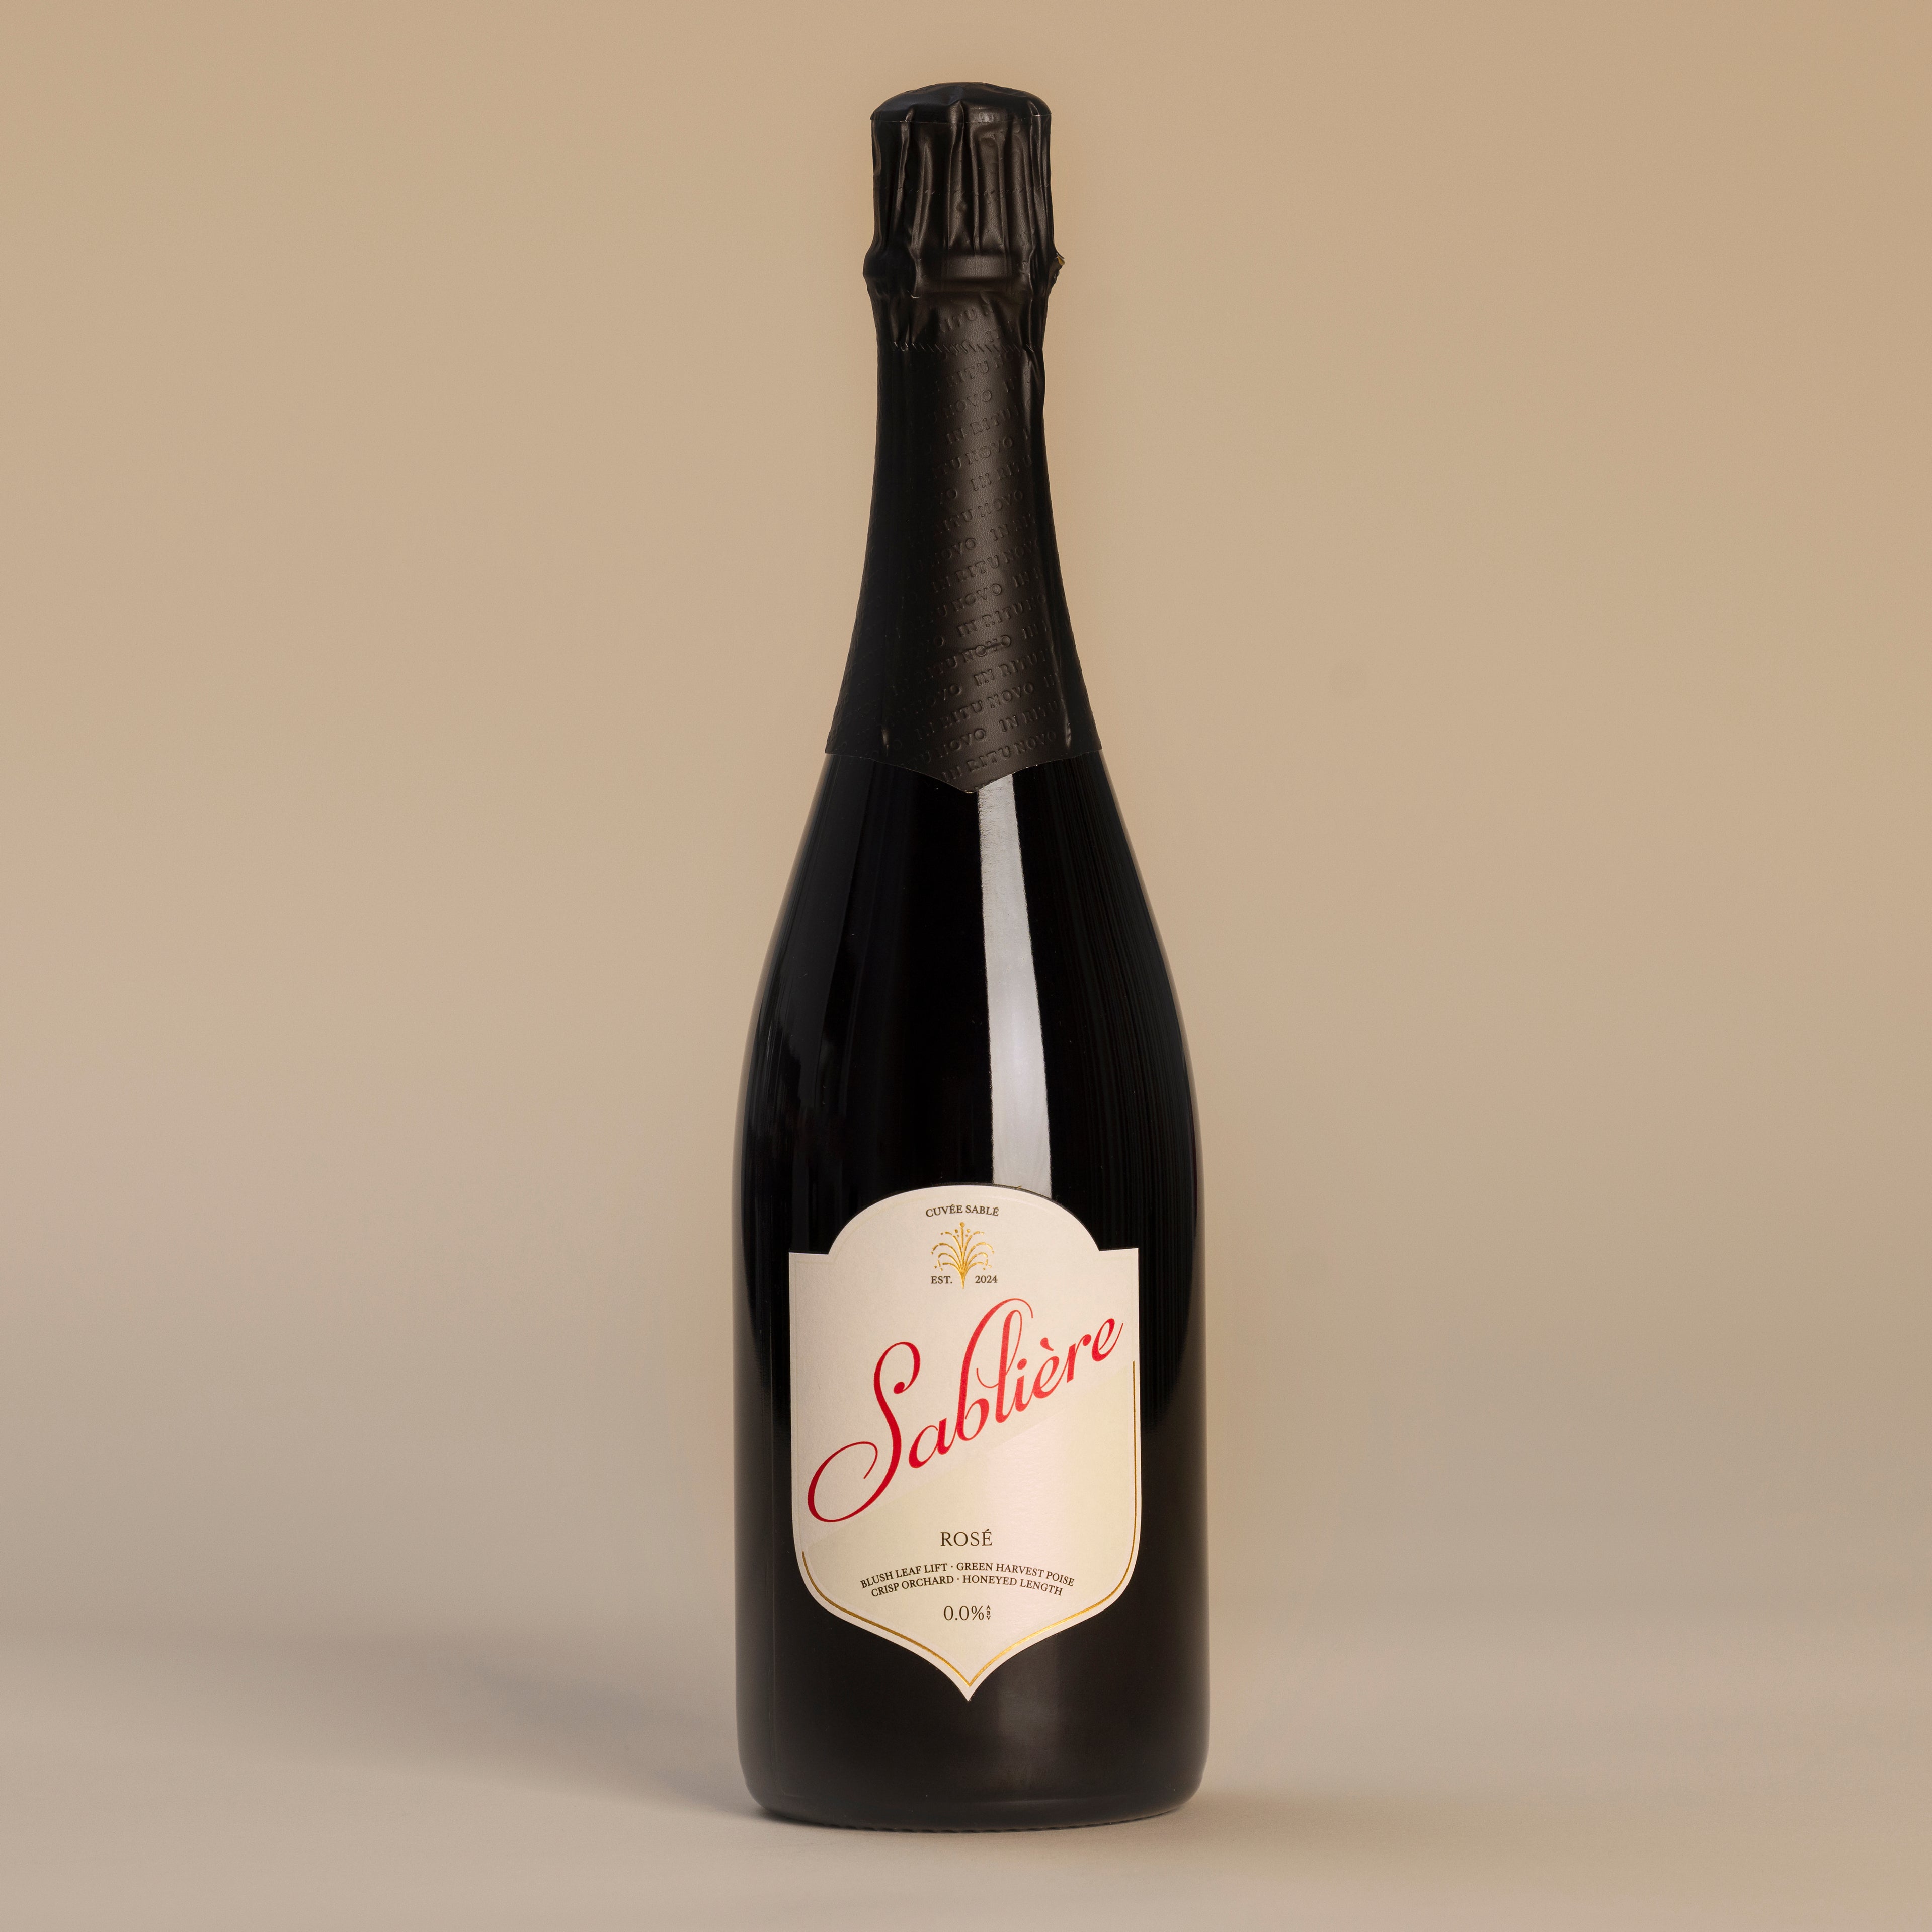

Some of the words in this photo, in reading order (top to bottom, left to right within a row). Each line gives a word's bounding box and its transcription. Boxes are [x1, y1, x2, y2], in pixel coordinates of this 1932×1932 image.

[945, 427, 965, 445] IN
[965, 436, 1013, 464] NOVO
[978, 489, 1023, 517] NOVO
[990, 523, 1010, 541] IN
[955, 555, 1000, 582] RITU
[951, 583, 1002, 612] NOVO
[956, 620, 978, 638] IN
[982, 602, 1024, 627] RITU
[974, 669, 995, 687] IN
[999, 653, 1037, 677] RITU
[939, 700, 983, 729] RITU
[988, 681, 1034, 709] NOVO
[935, 728, 986, 759] NOVO
[999, 715, 1019, 732] IN
[967, 746, 1010, 772] RITU
[1014, 731, 1056, 755] NOVO
[925, 1203, 963, 1218] CUVÉE
[965, 1205, 1000, 1217] SABLÉ
[930, 1275, 953, 1284] EST.
[975, 1275, 998, 1284] 2024
[807, 1298, 1124, 1523] Sablière
[940, 1528, 993, 1547] ROSÉ
[860, 1571, 894, 1589] BLUSH
[895, 1566, 922, 1578] LEAF
[924, 1563, 948, 1574] LIFT
[956, 1562, 993, 1571] GREEN
[996, 1563, 1044, 1578] HARVEST
[1045, 1571, 1075, 1587] POISE
[871, 1582, 900, 1597] CRISP
[901, 1575, 954, 1590] ORCHARD
[962, 1575, 1017, 1586] HONEYED
[1019, 1579, 1063, 1596] LENGTH
[943, 1605, 984, 1621] 0.0%
